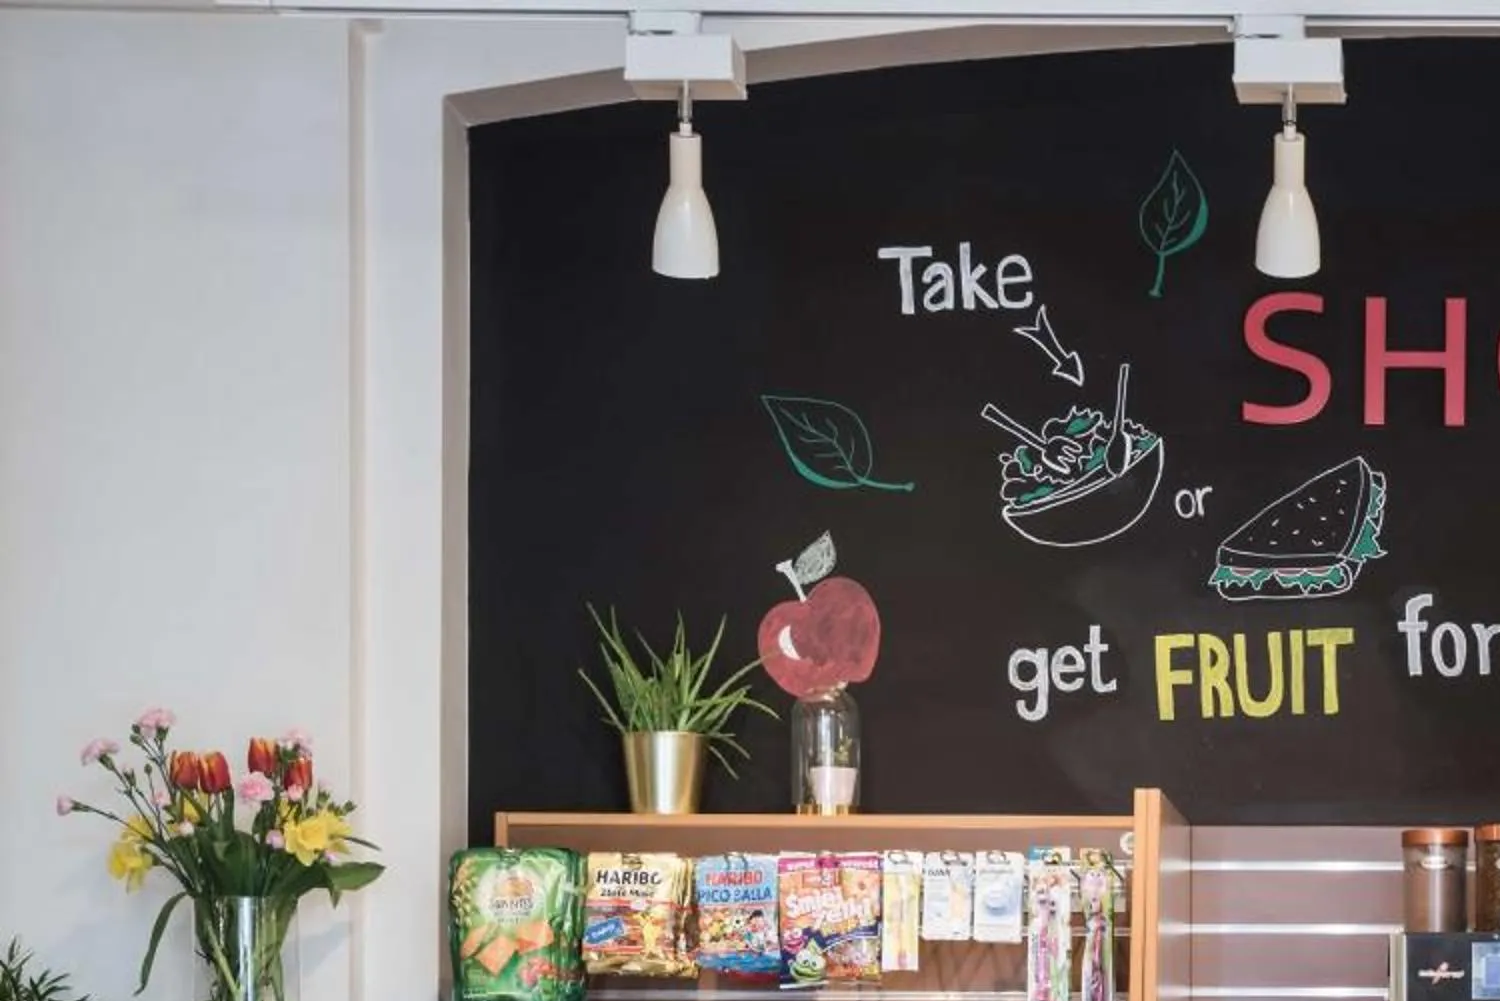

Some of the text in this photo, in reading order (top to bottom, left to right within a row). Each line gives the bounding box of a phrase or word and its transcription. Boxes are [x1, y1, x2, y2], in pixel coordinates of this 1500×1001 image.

[877, 242, 1034, 315] Take
[1174, 483, 1213, 519] or
[1007, 623, 1118, 722] get
[1153, 627, 1355, 721] FRUIT
[596, 868, 662, 885] HARIBO
